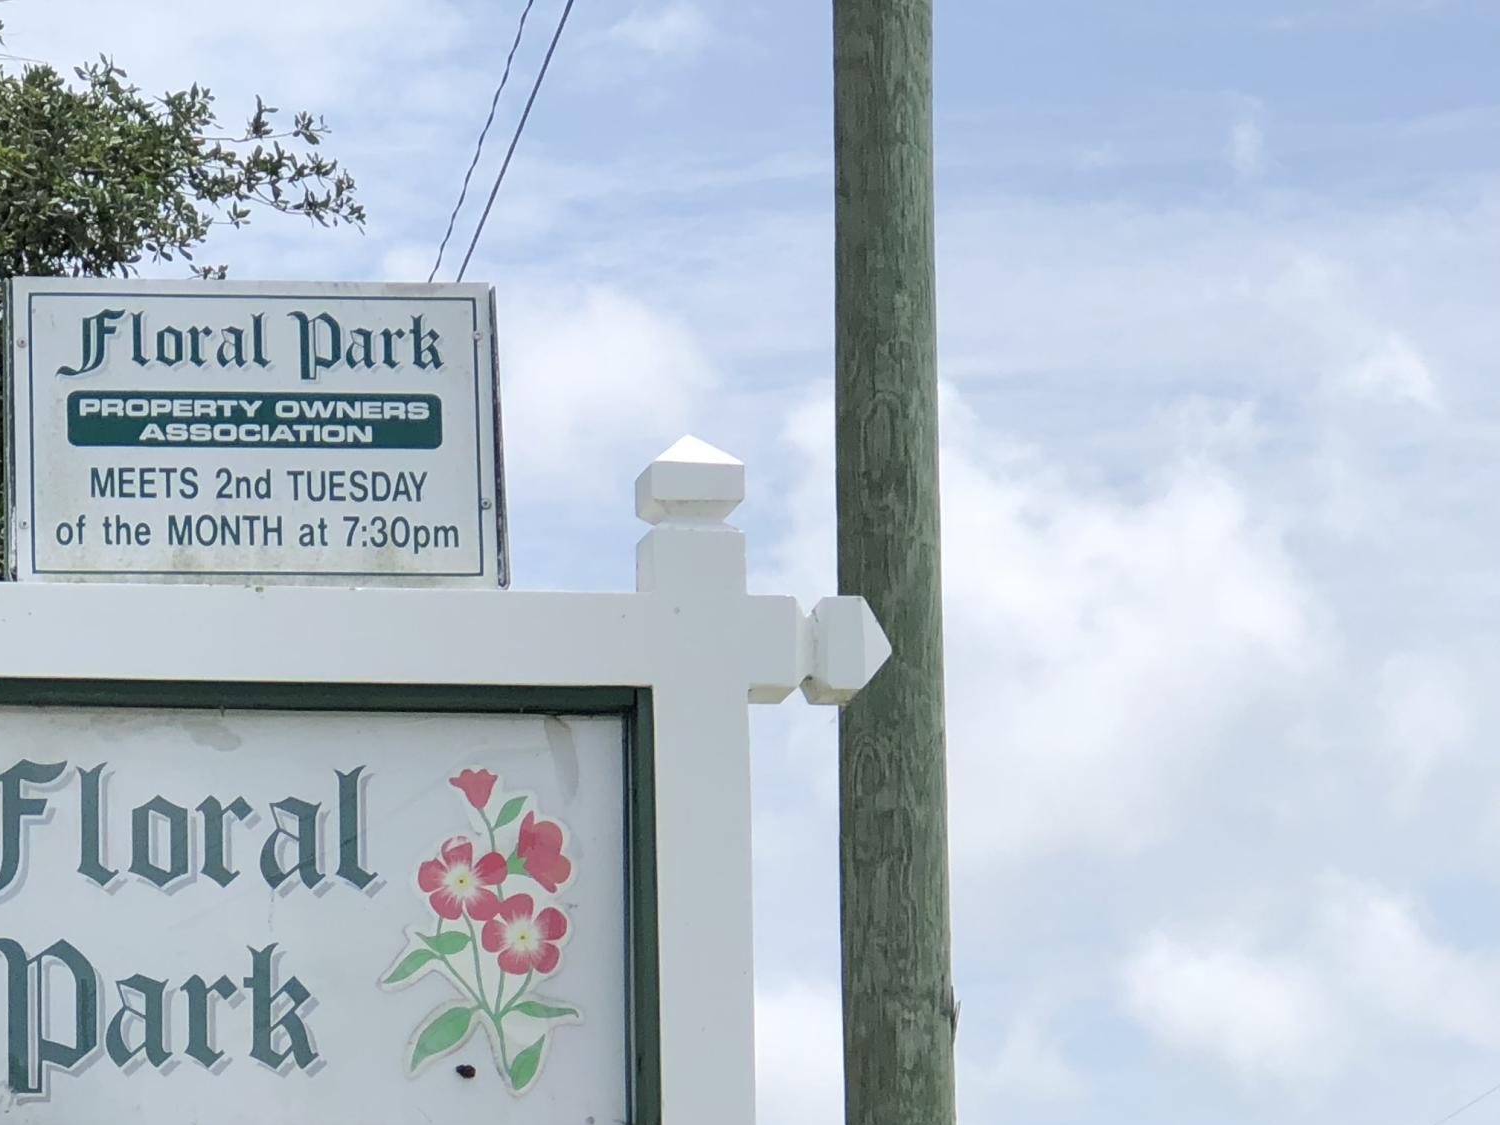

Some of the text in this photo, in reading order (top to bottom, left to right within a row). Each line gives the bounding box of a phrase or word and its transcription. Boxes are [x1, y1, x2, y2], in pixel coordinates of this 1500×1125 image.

[56, 308, 445, 380] Floral Park
[79, 398, 430, 420] PROPERTY OWNERS
[139, 423, 373, 443] ASSOCIATION
[90, 467, 428, 503] MEETS 2nd TUESDAY
[56, 514, 459, 554] of the MONTH at 7:30pm
